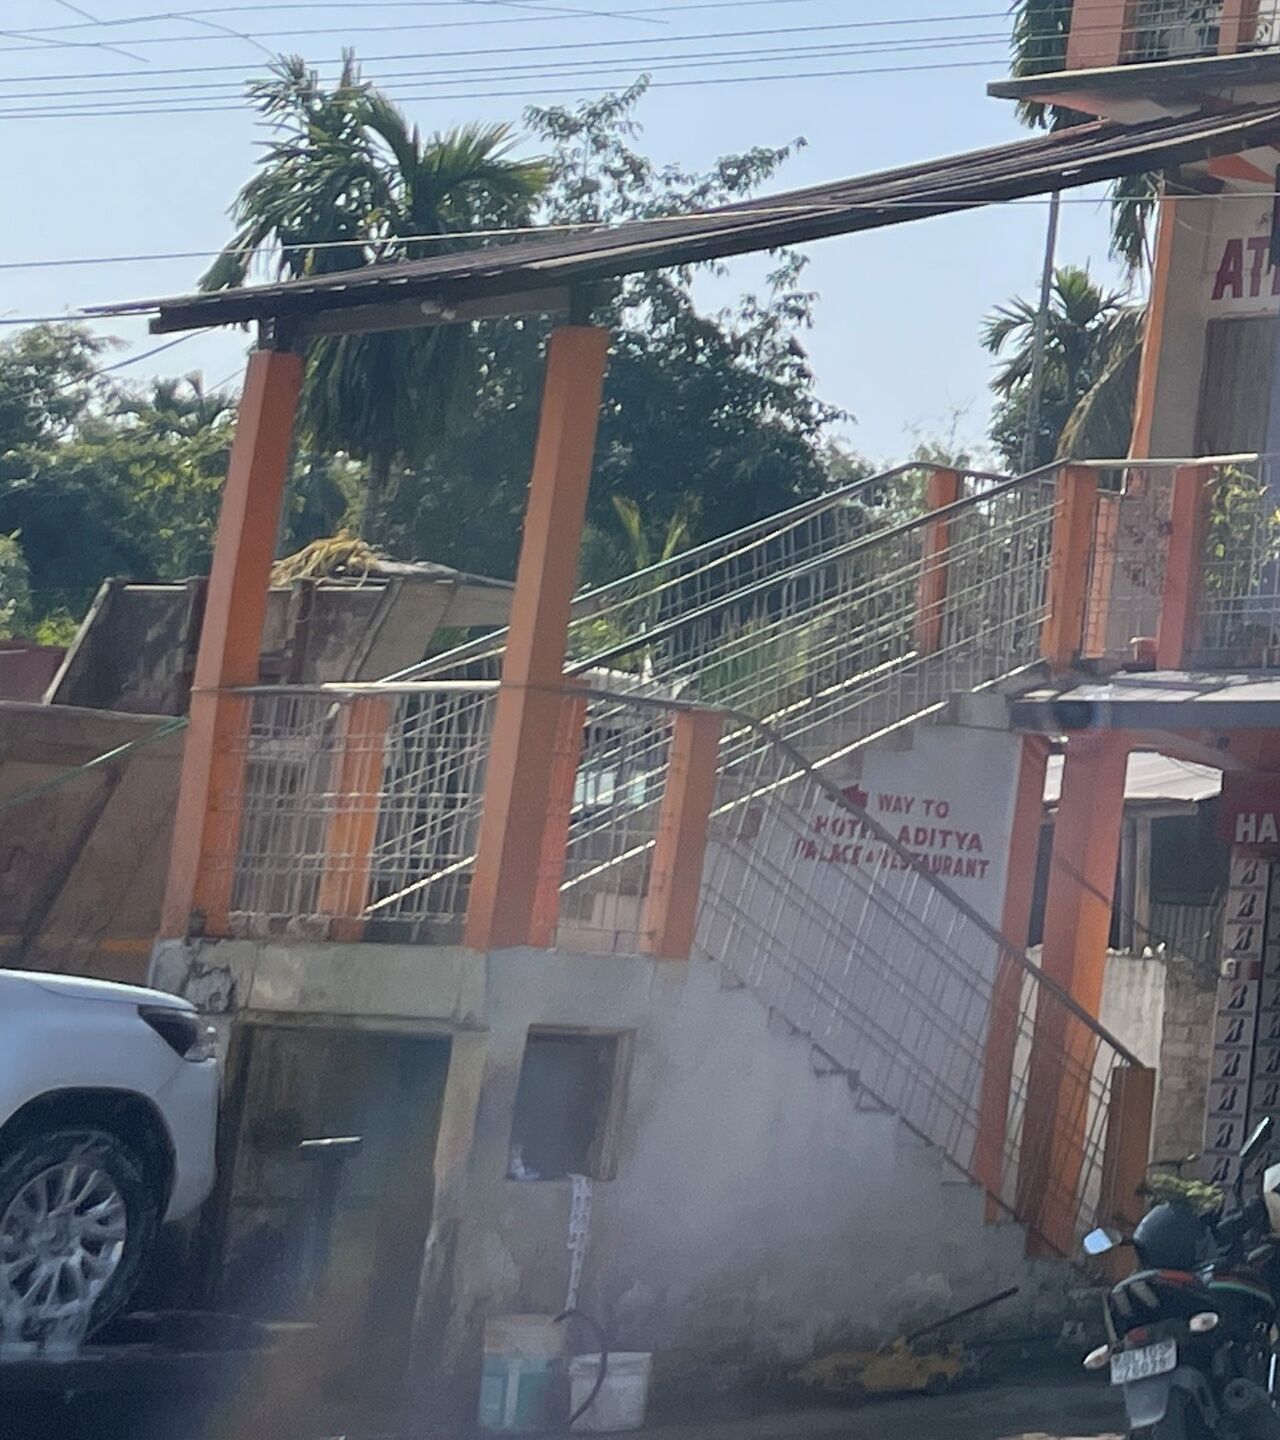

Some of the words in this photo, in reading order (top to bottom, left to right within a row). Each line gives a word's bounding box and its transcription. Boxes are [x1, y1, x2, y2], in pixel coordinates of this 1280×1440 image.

[878, 792, 915, 815] WAY
[922, 799, 950, 819] TO
[899, 825, 984, 852] ADITYA
